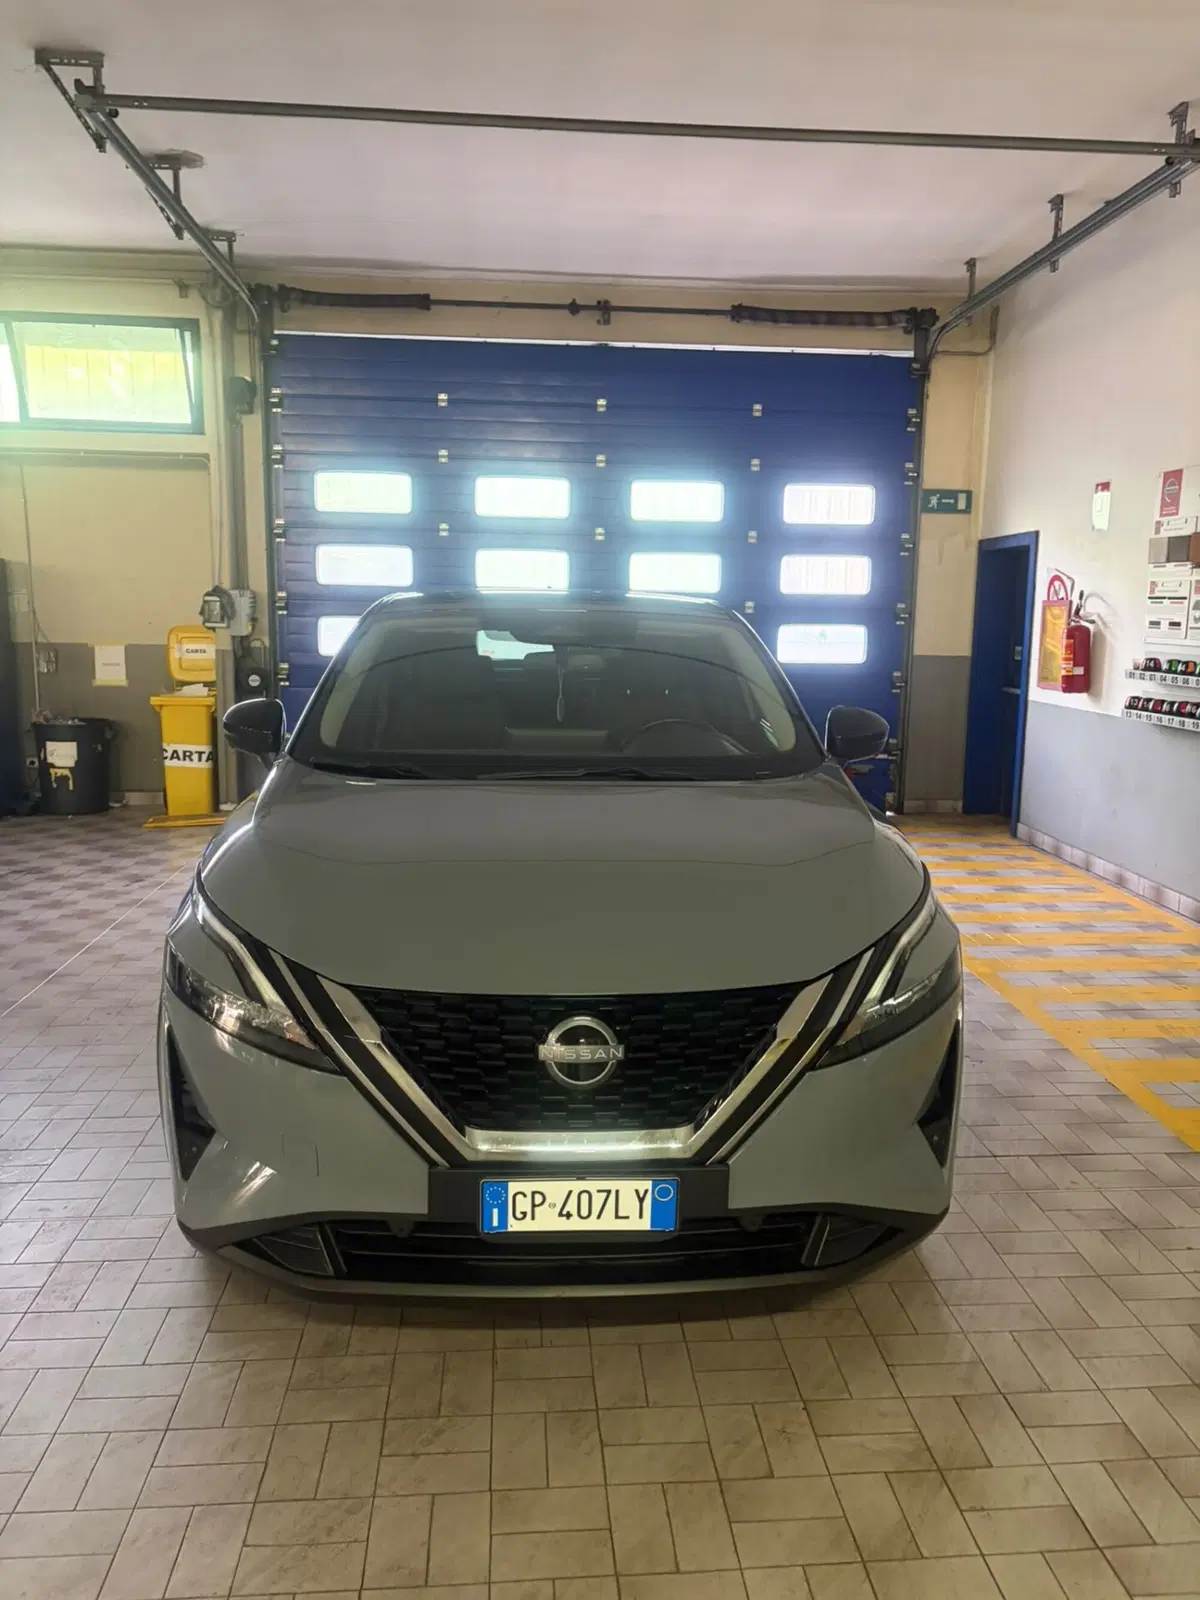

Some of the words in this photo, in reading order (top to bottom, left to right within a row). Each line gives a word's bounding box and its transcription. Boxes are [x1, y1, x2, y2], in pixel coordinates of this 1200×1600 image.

[541, 1047, 622, 1060] NISSAN
[512, 1190, 546, 1221] GP
[558, 1188, 649, 1220] 407LY
